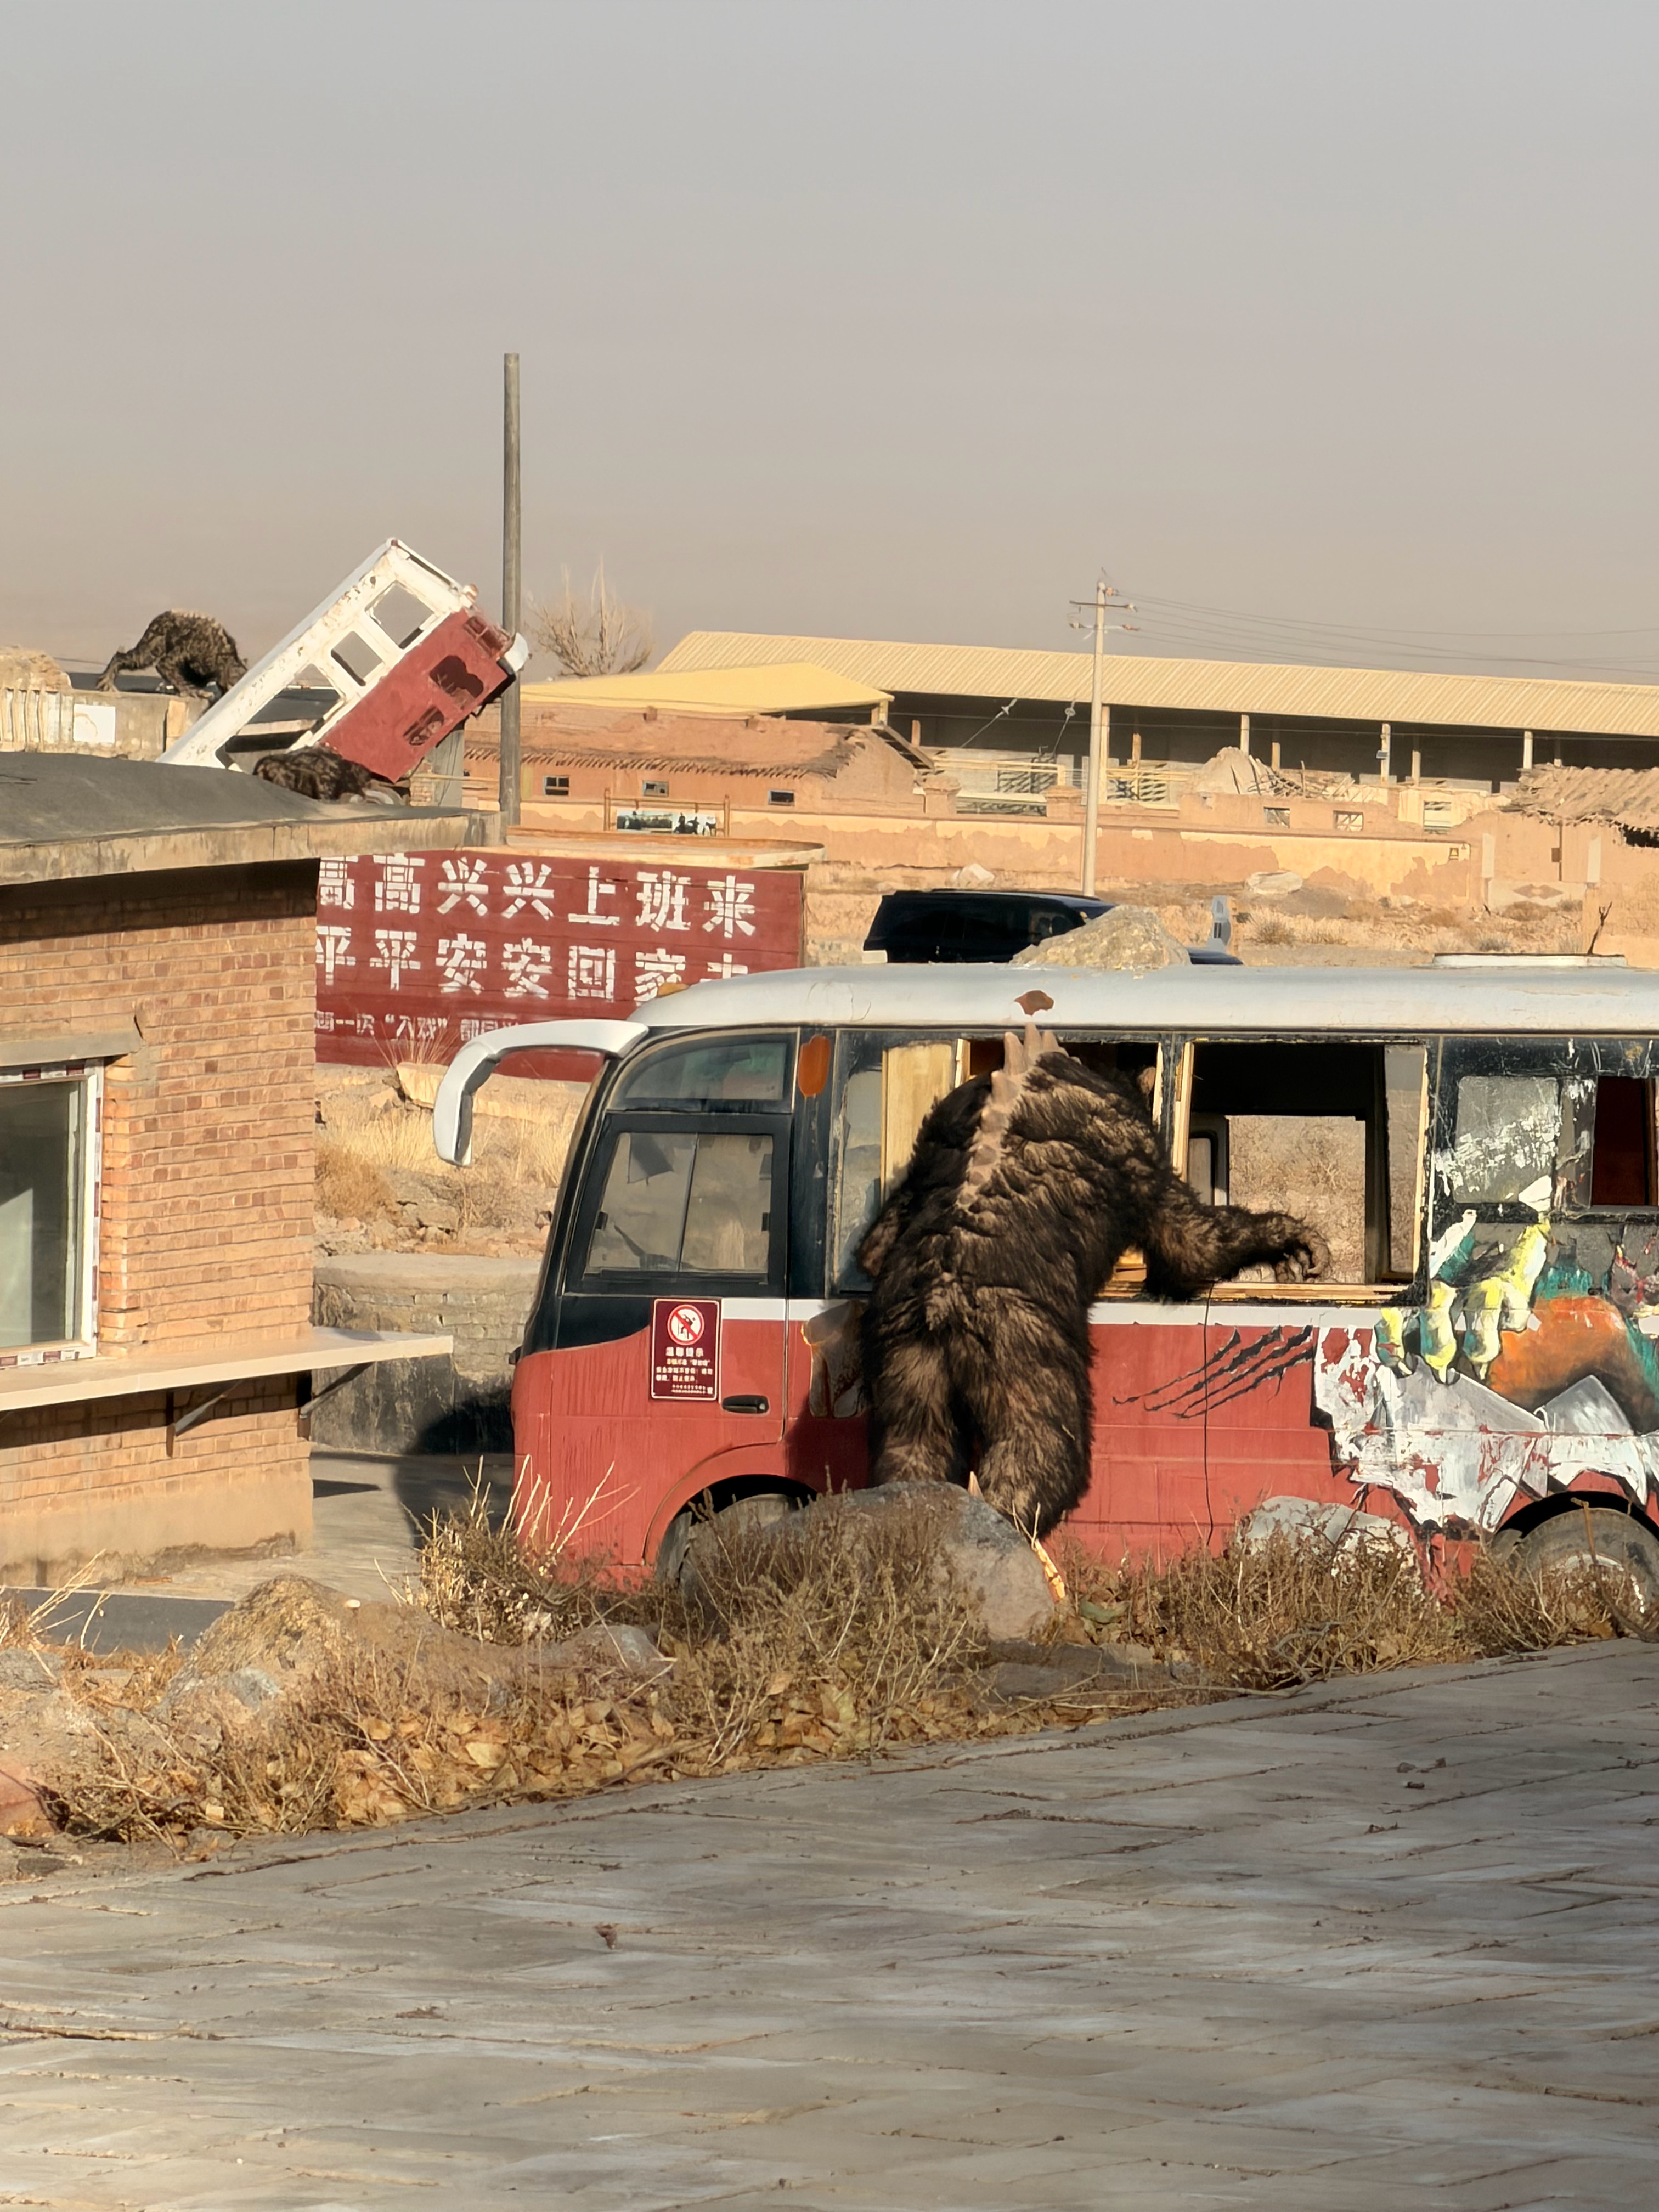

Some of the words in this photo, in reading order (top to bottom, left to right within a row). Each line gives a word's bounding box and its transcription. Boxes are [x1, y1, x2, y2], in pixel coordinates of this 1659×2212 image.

[319, 853, 755, 938] 高高兴兴上班来
